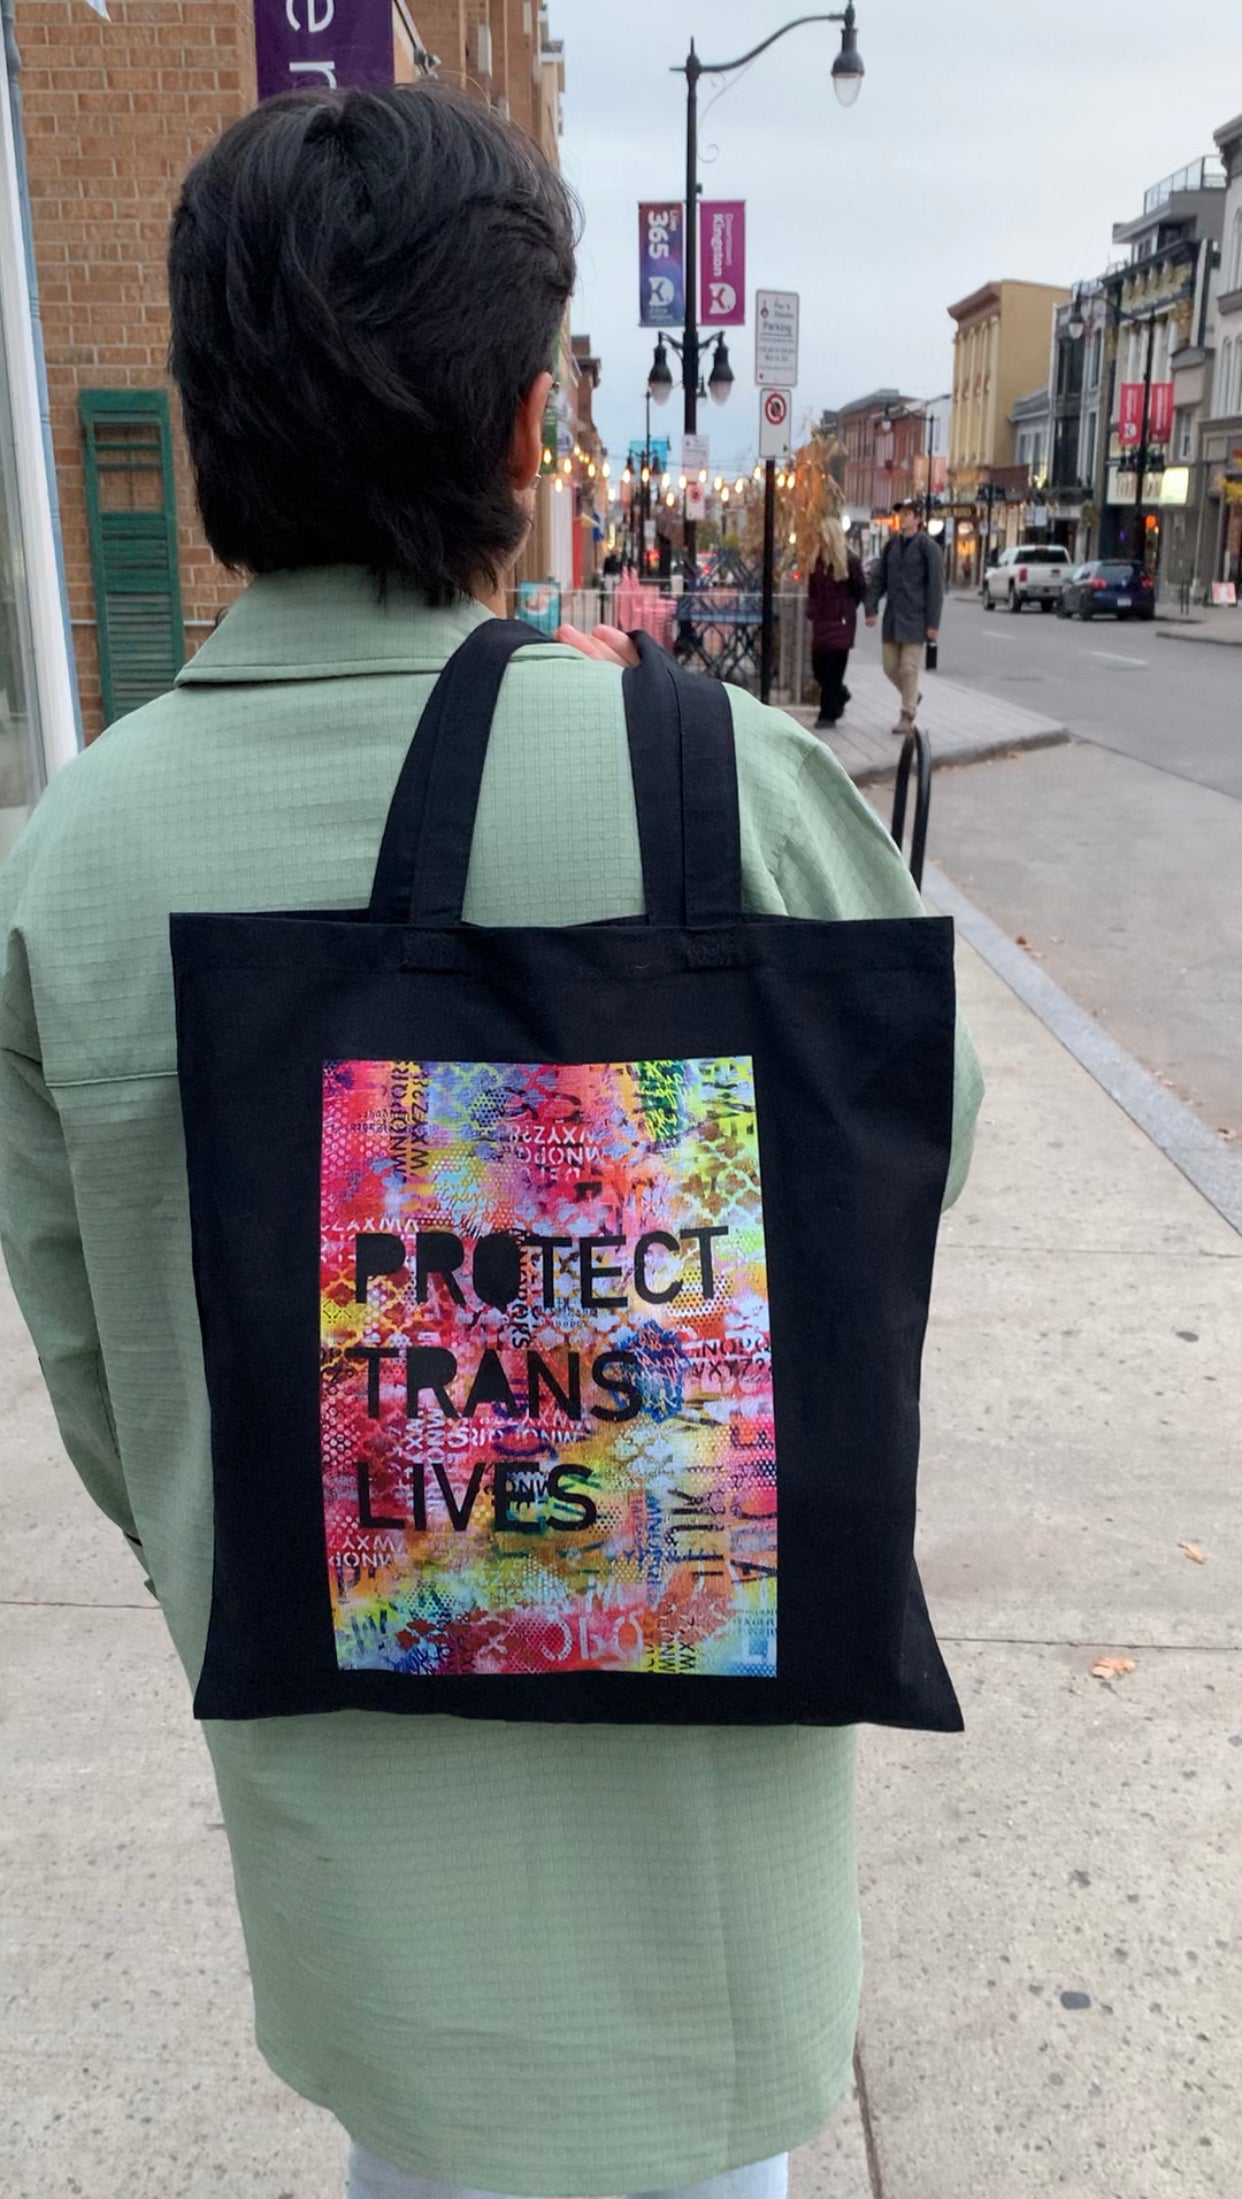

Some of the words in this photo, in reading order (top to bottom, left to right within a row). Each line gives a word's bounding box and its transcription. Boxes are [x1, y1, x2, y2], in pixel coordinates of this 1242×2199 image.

[648, 210, 669, 259] 365
[711, 213, 724, 277] Kingston
[355, 1226, 730, 1309] PROTECT
[344, 1346, 645, 1421] TRANS
[357, 1462, 598, 1531] LIVES
